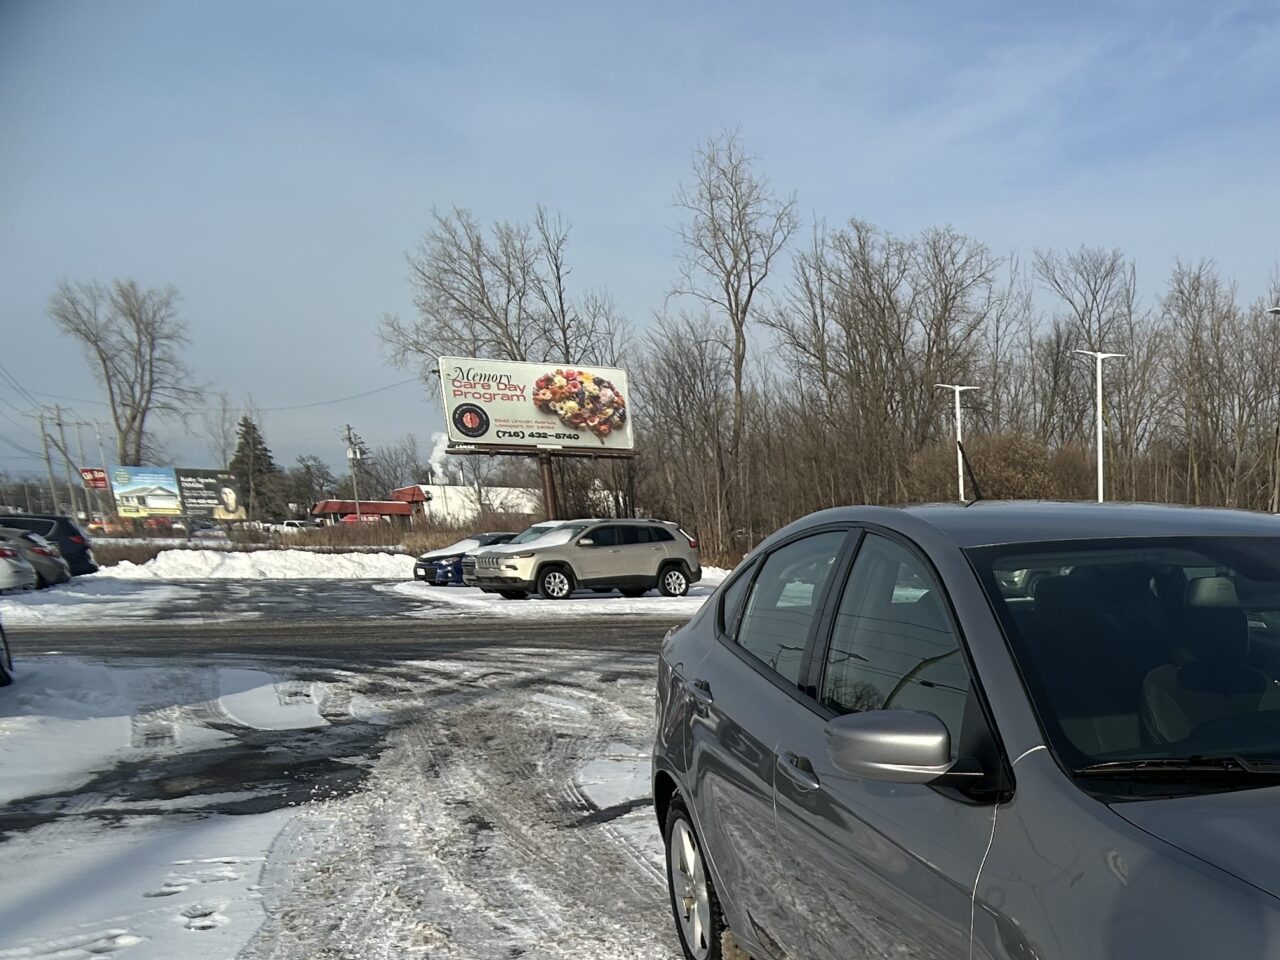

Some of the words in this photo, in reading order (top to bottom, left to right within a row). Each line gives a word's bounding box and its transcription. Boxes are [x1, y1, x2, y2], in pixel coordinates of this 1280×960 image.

[446, 366, 512, 384] Memory
[452, 380, 491, 390] Care
[496, 382, 526, 394] Day
[453, 389, 527, 403] Program
[496, 430, 525, 440] (716)
